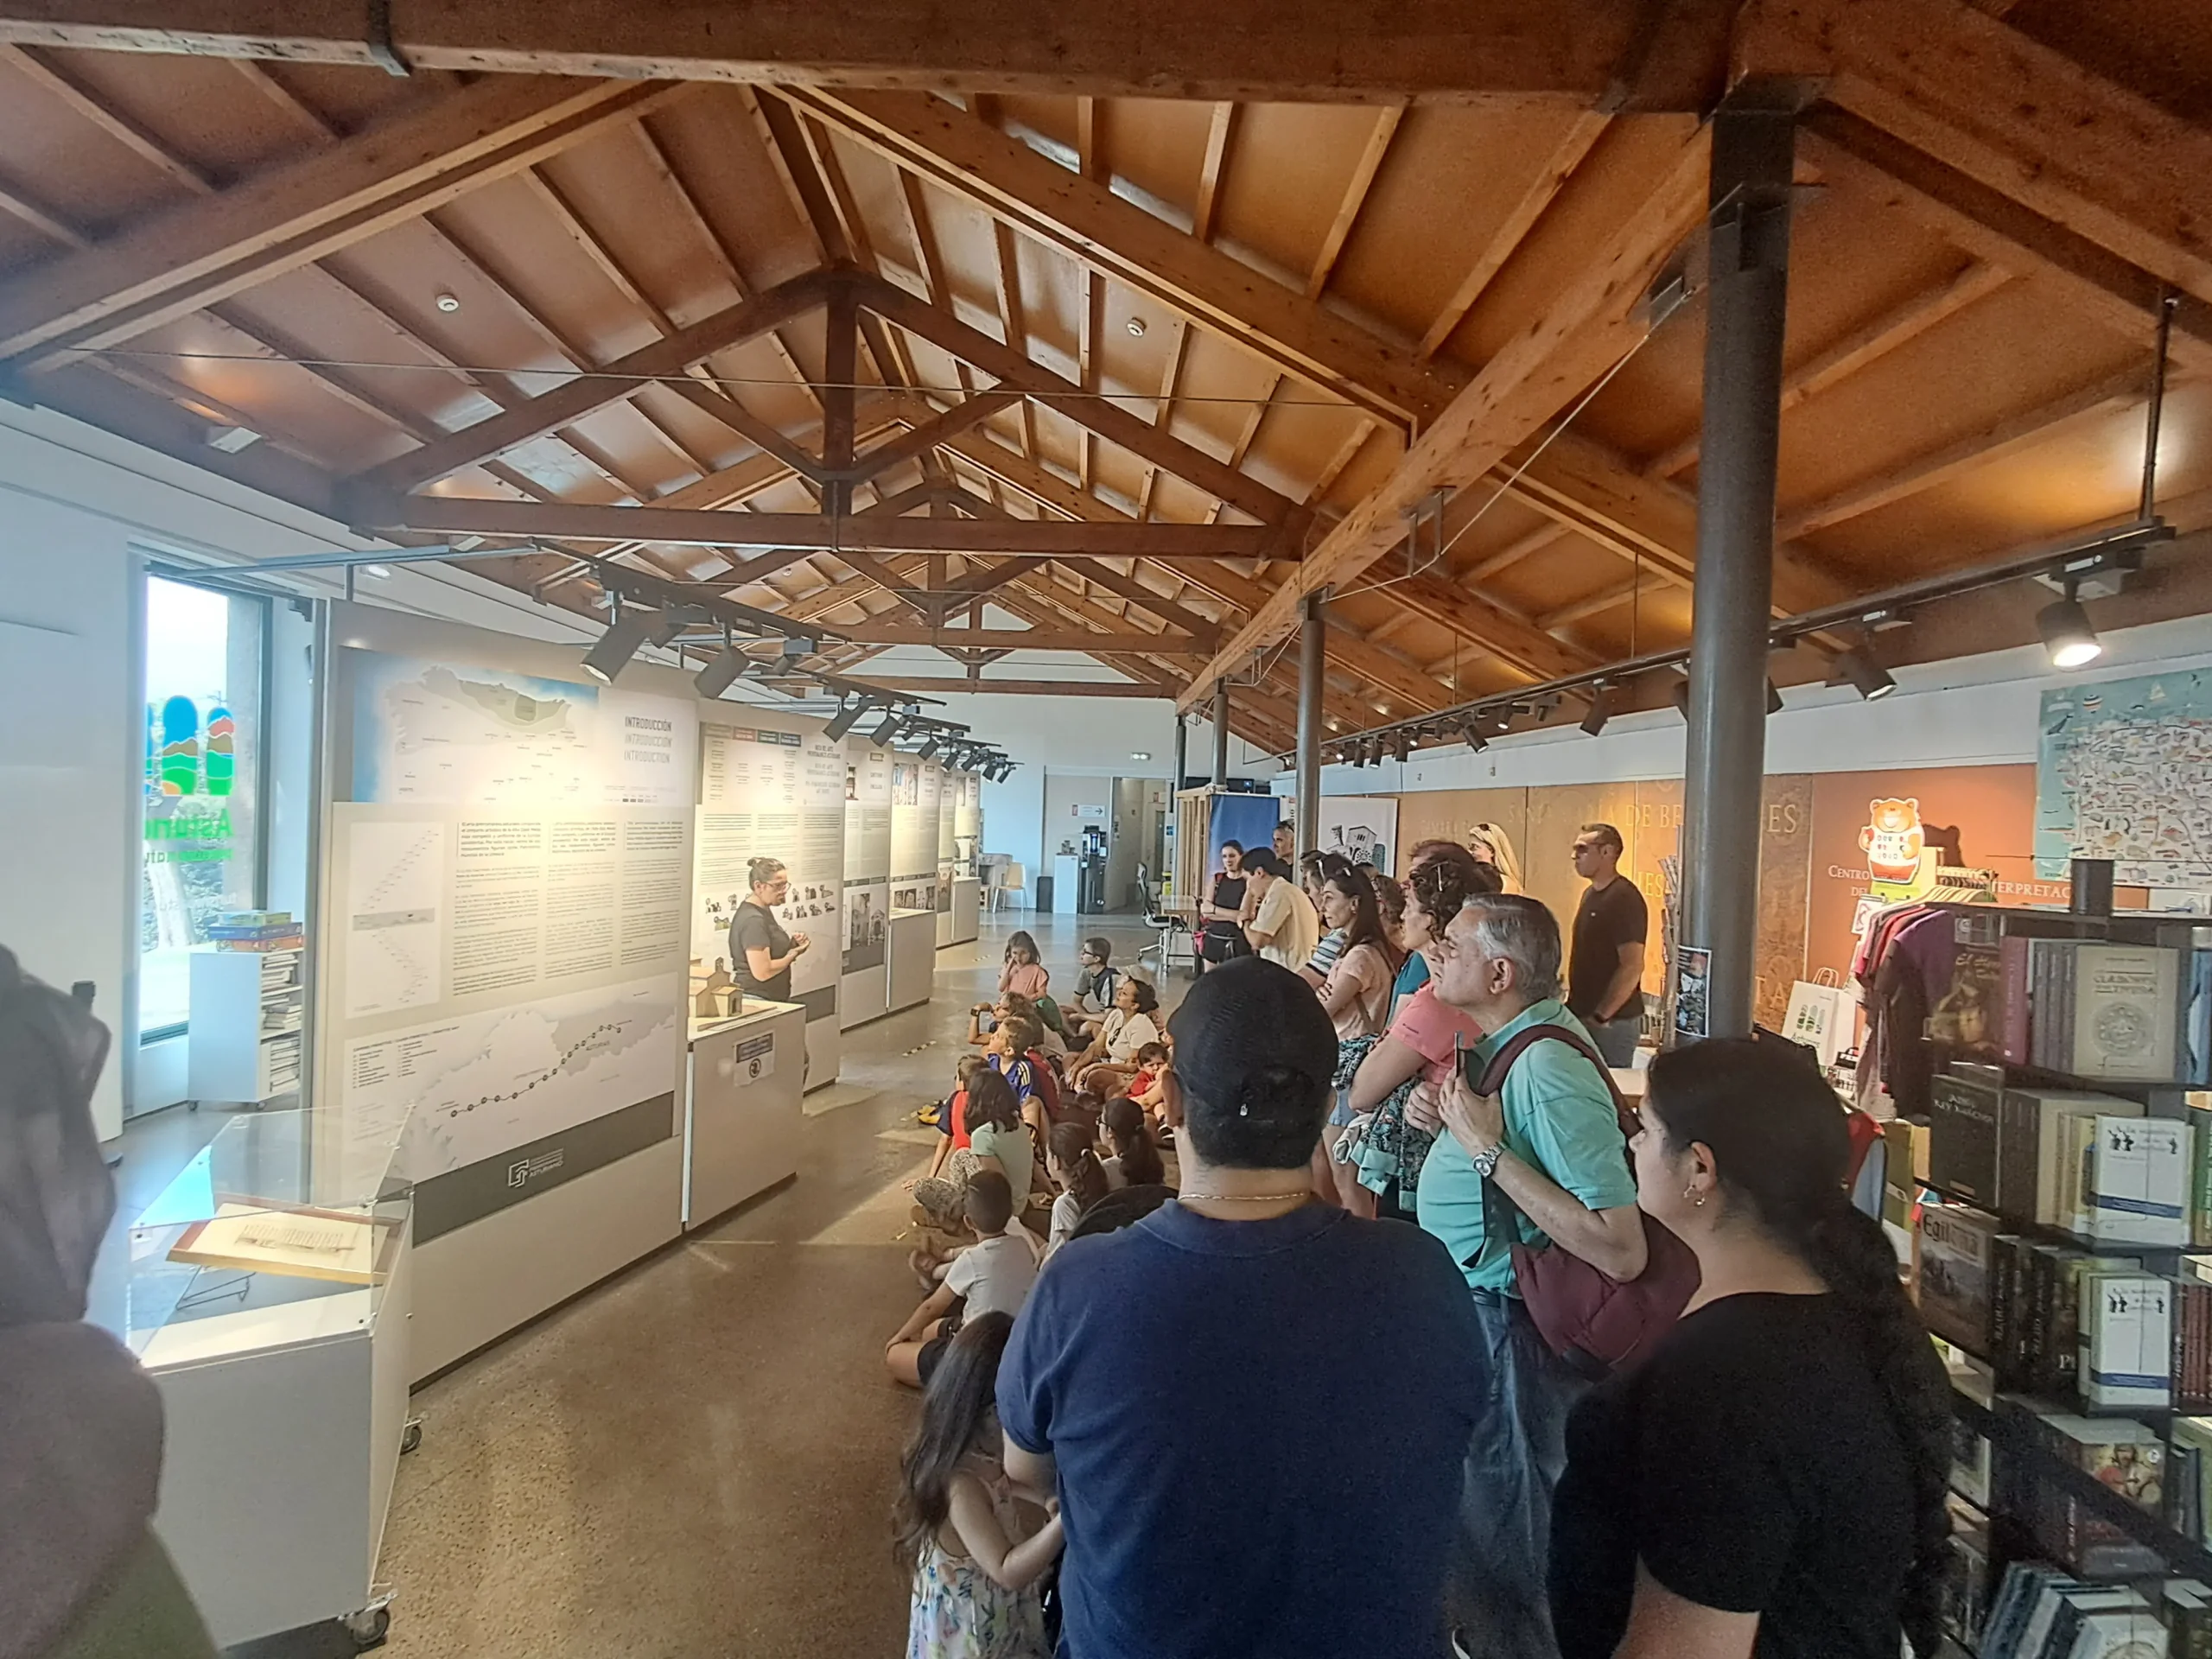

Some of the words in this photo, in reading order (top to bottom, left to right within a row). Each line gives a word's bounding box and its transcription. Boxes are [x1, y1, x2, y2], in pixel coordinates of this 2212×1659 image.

[625, 715, 672, 732] INTRODUCCIÓN
[1625, 804, 1651, 828] DE
[1827, 864, 1871, 880] CENTRO
[1991, 880, 2072, 899] TERPRETAC
